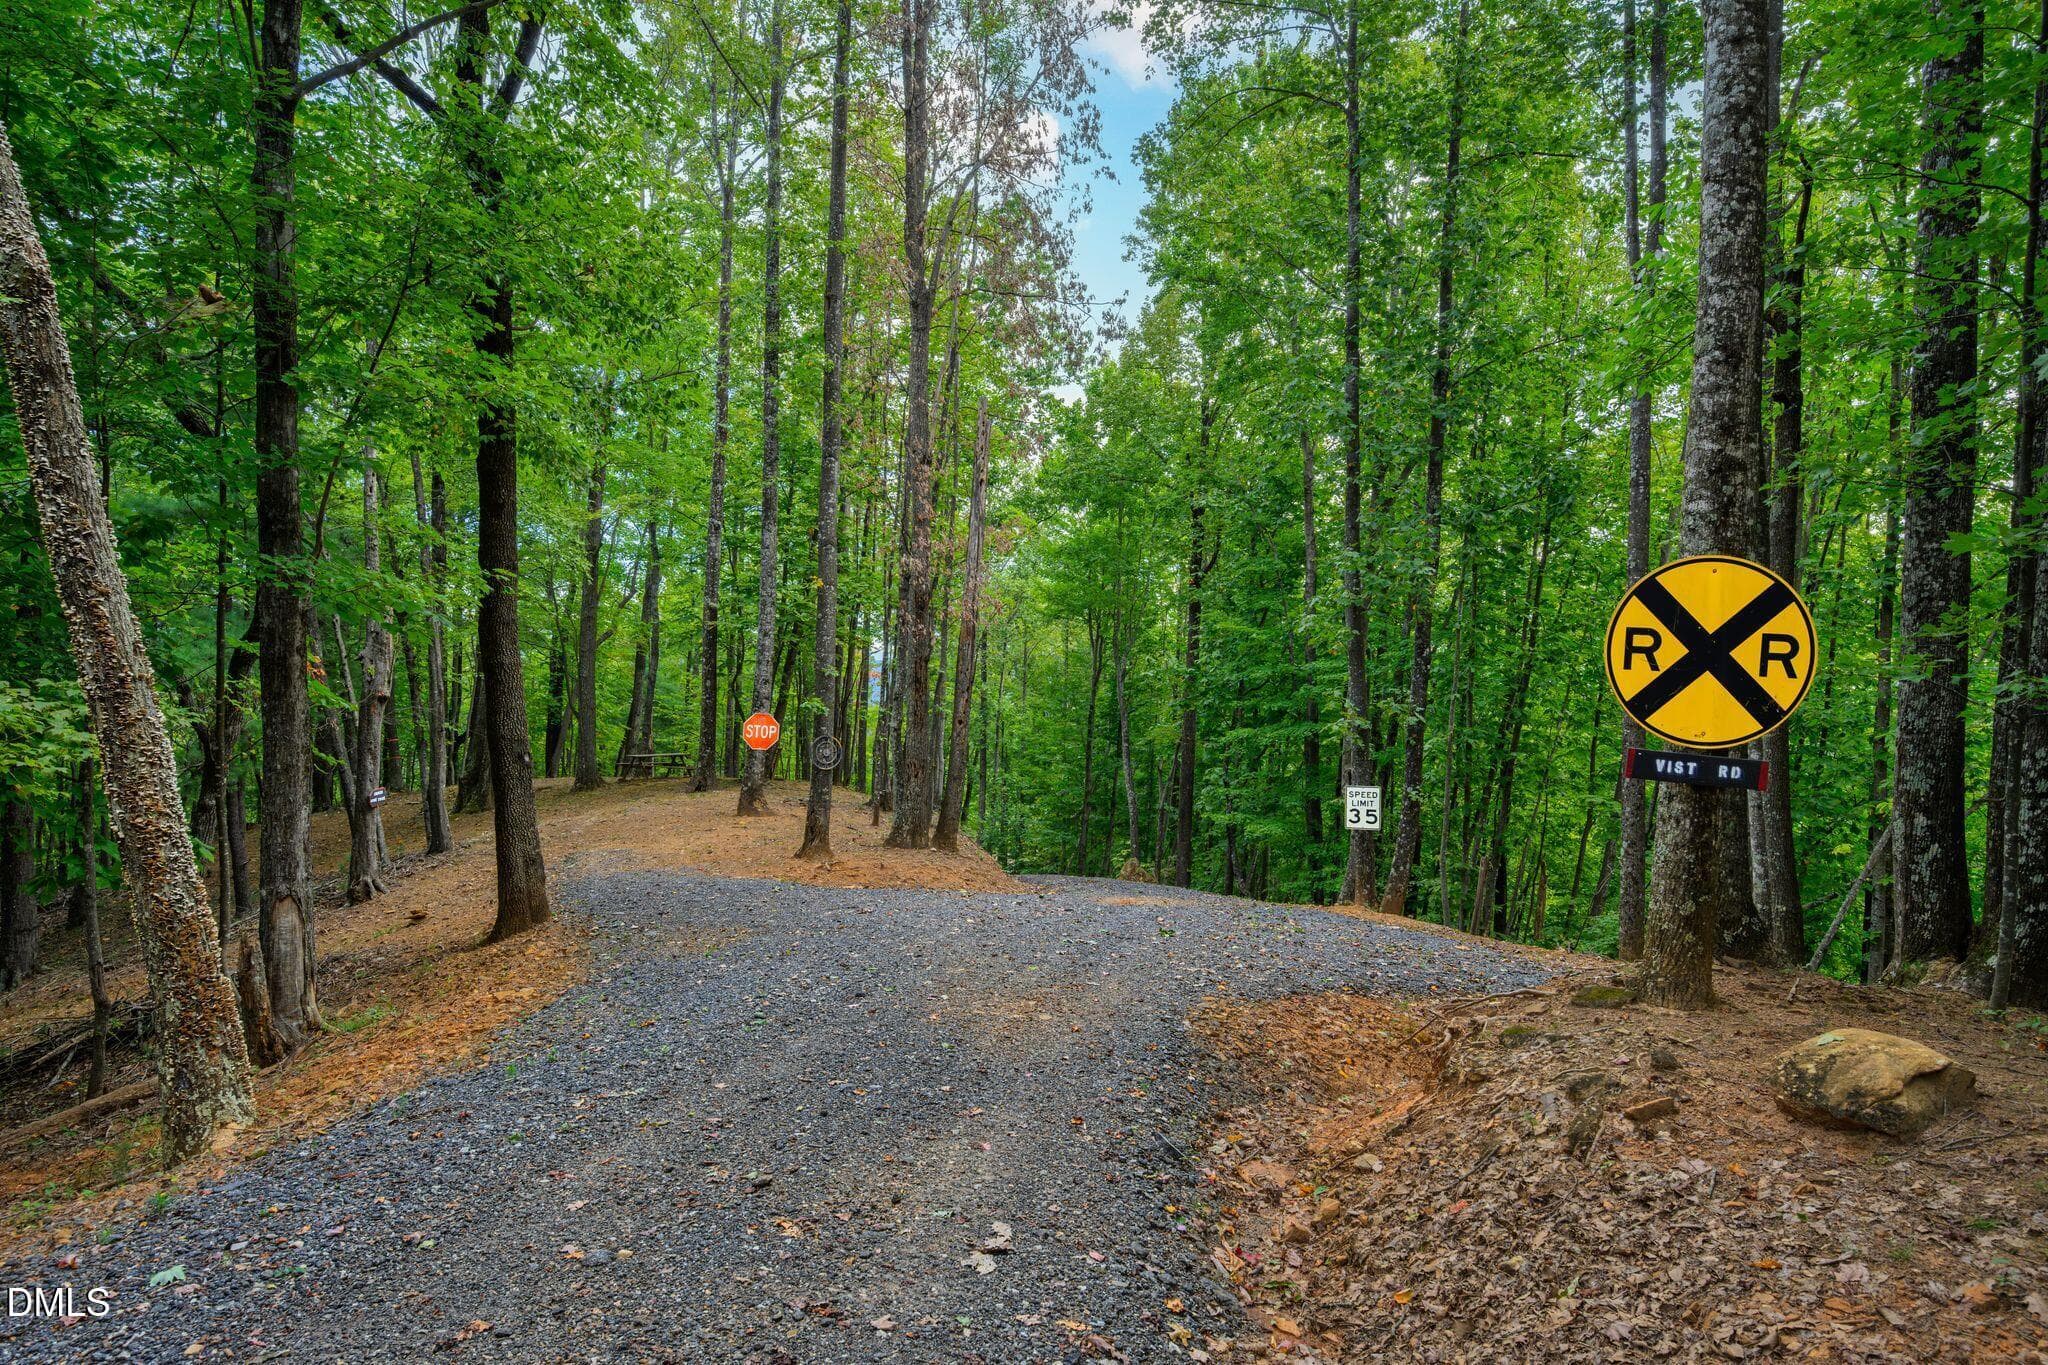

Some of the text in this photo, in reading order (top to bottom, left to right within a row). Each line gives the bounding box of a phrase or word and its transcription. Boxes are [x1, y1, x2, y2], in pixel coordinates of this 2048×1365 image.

[1623, 627, 1800, 679] R R
[746, 724, 777, 739] STOP
[1655, 758, 1742, 779] VIST RD
[1348, 791, 1378, 799] SPEED
[1348, 808, 1378, 825] 35
